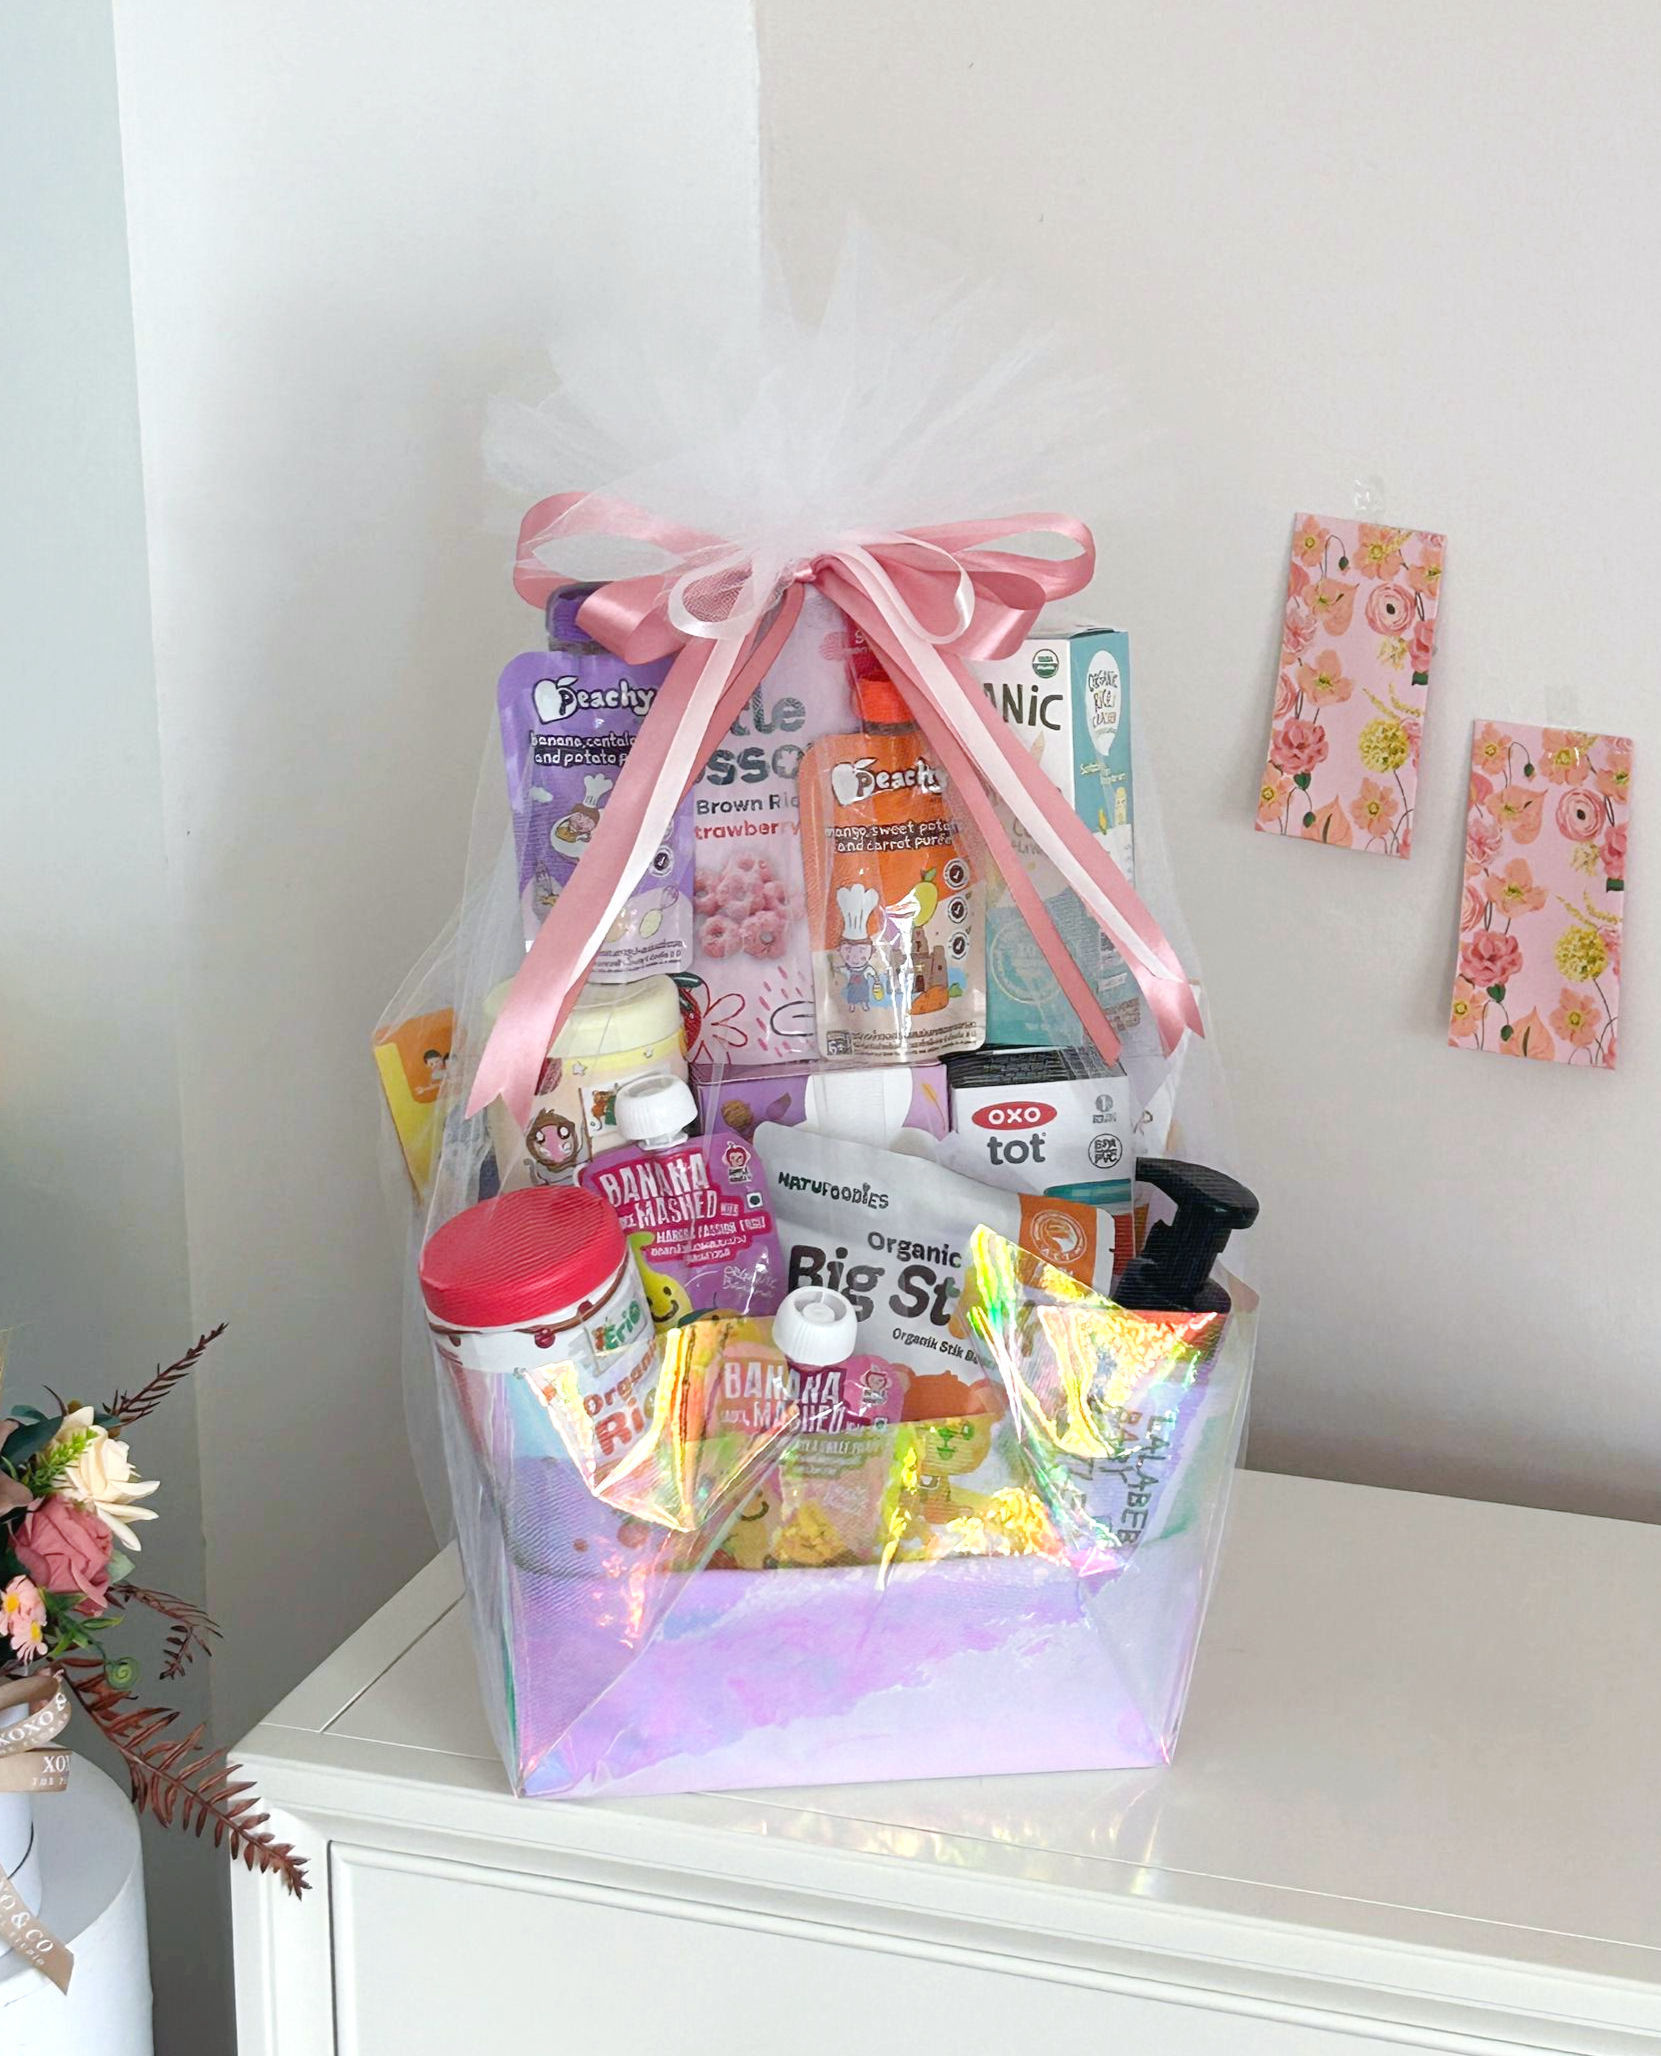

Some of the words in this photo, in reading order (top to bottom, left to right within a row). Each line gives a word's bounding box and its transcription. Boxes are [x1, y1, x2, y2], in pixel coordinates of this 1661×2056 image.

[557, 678, 657, 716] Peachy
[534, 749, 561, 764] and
[564, 749, 617, 767] potato
[696, 798, 763, 815] Brown
[837, 841, 864, 853] and
[866, 838, 912, 851] carrot
[872, 822, 915, 838] sweet
[988, 1106, 1042, 1125] OXO
[986, 1133, 1046, 1166] tot
[599, 1153, 710, 1208] BANANA
[634, 1190, 718, 1229] MASHED
[867, 1231, 963, 1269] Organic
[787, 1244, 886, 1323] Big
[892, 1328, 938, 1351] Organik
[938, 1340, 965, 1360] Stik
[723, 1361, 843, 1405] BANANA
[752, 1400, 847, 1435] MAHED
[11, 1911, 31, 1929] &
[25, 1929, 54, 1953] CO
